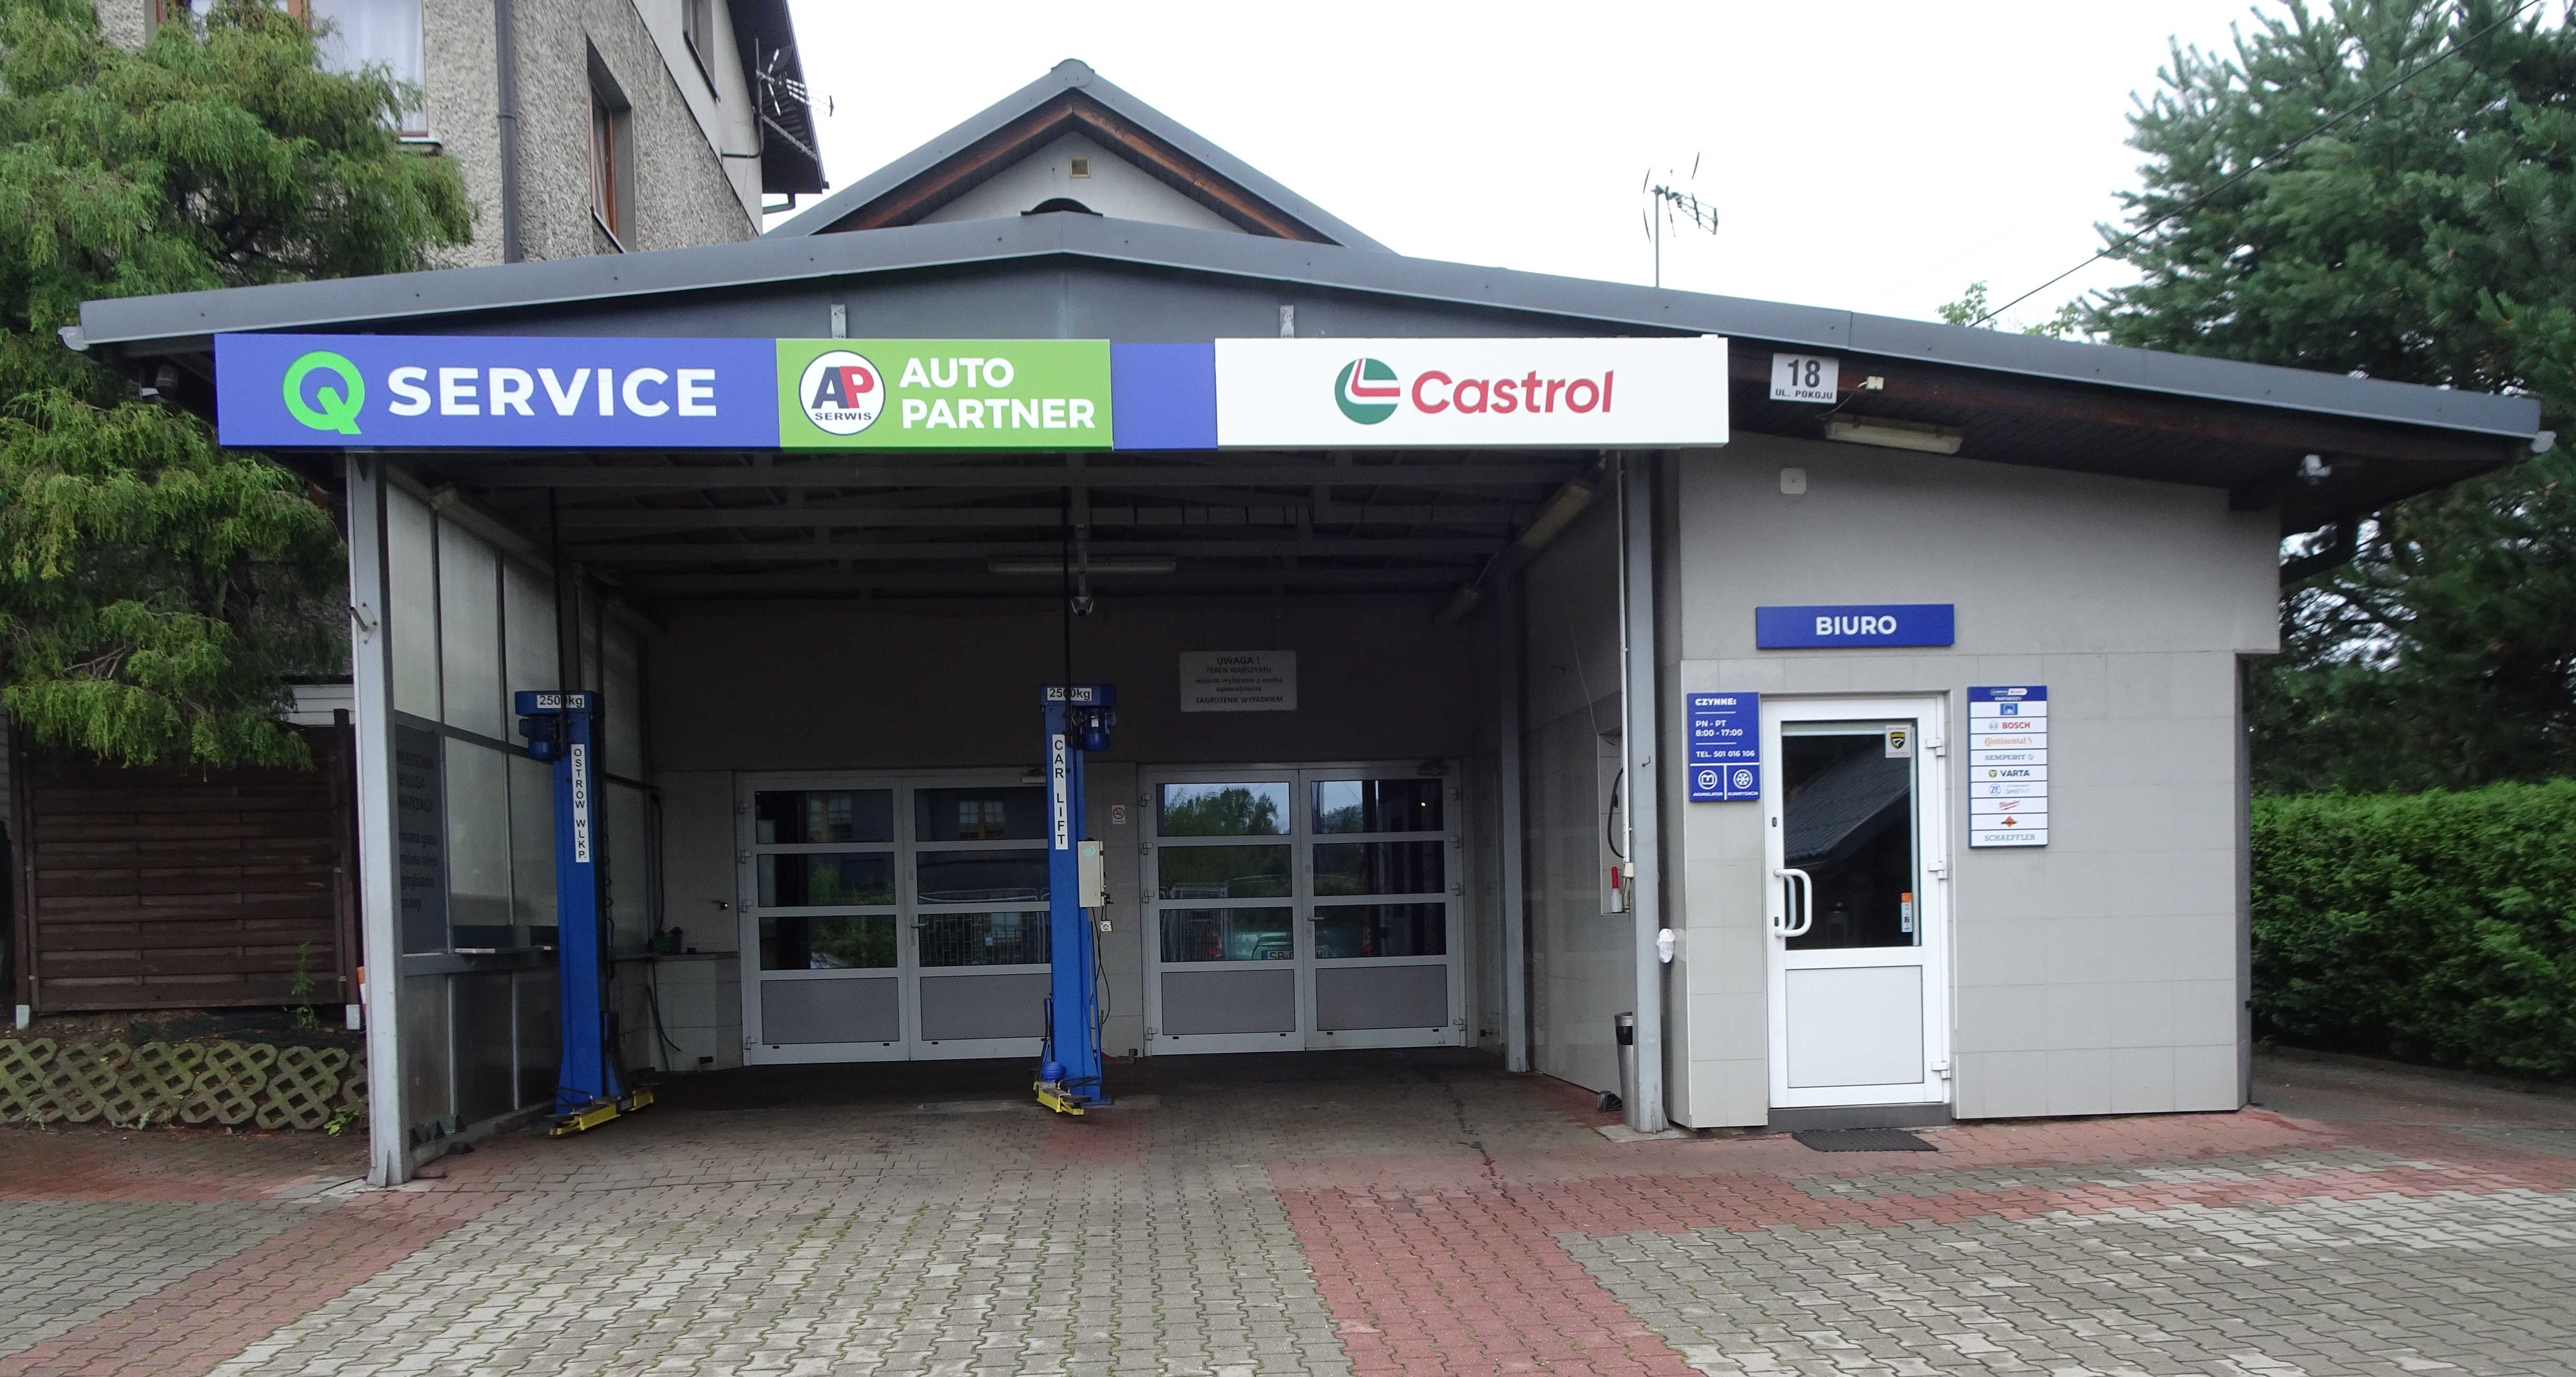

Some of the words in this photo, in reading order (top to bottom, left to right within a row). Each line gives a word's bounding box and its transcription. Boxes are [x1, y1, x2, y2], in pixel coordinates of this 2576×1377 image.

[811, 366, 874, 409] AP
[899, 357, 1014, 388] AUTO
[1788, 359, 1820, 387] 18
[282, 350, 365, 435] Q
[388, 366, 717, 417] SERVICE
[1412, 369, 1614, 414] Castrol
[1775, 388, 1790, 397] UL.
[1795, 390, 1833, 399] POKOJU
[815, 412, 872, 421] SERWIS
[902, 398, 1095, 429] PARTNER
[1816, 615, 1897, 636] BIURO
[1217, 656, 1253, 665] UWAGA
[1985, 737, 2026, 746] Continental
[1054, 740, 1064, 778] CAR
[1056, 793, 1065, 845] LIFT
